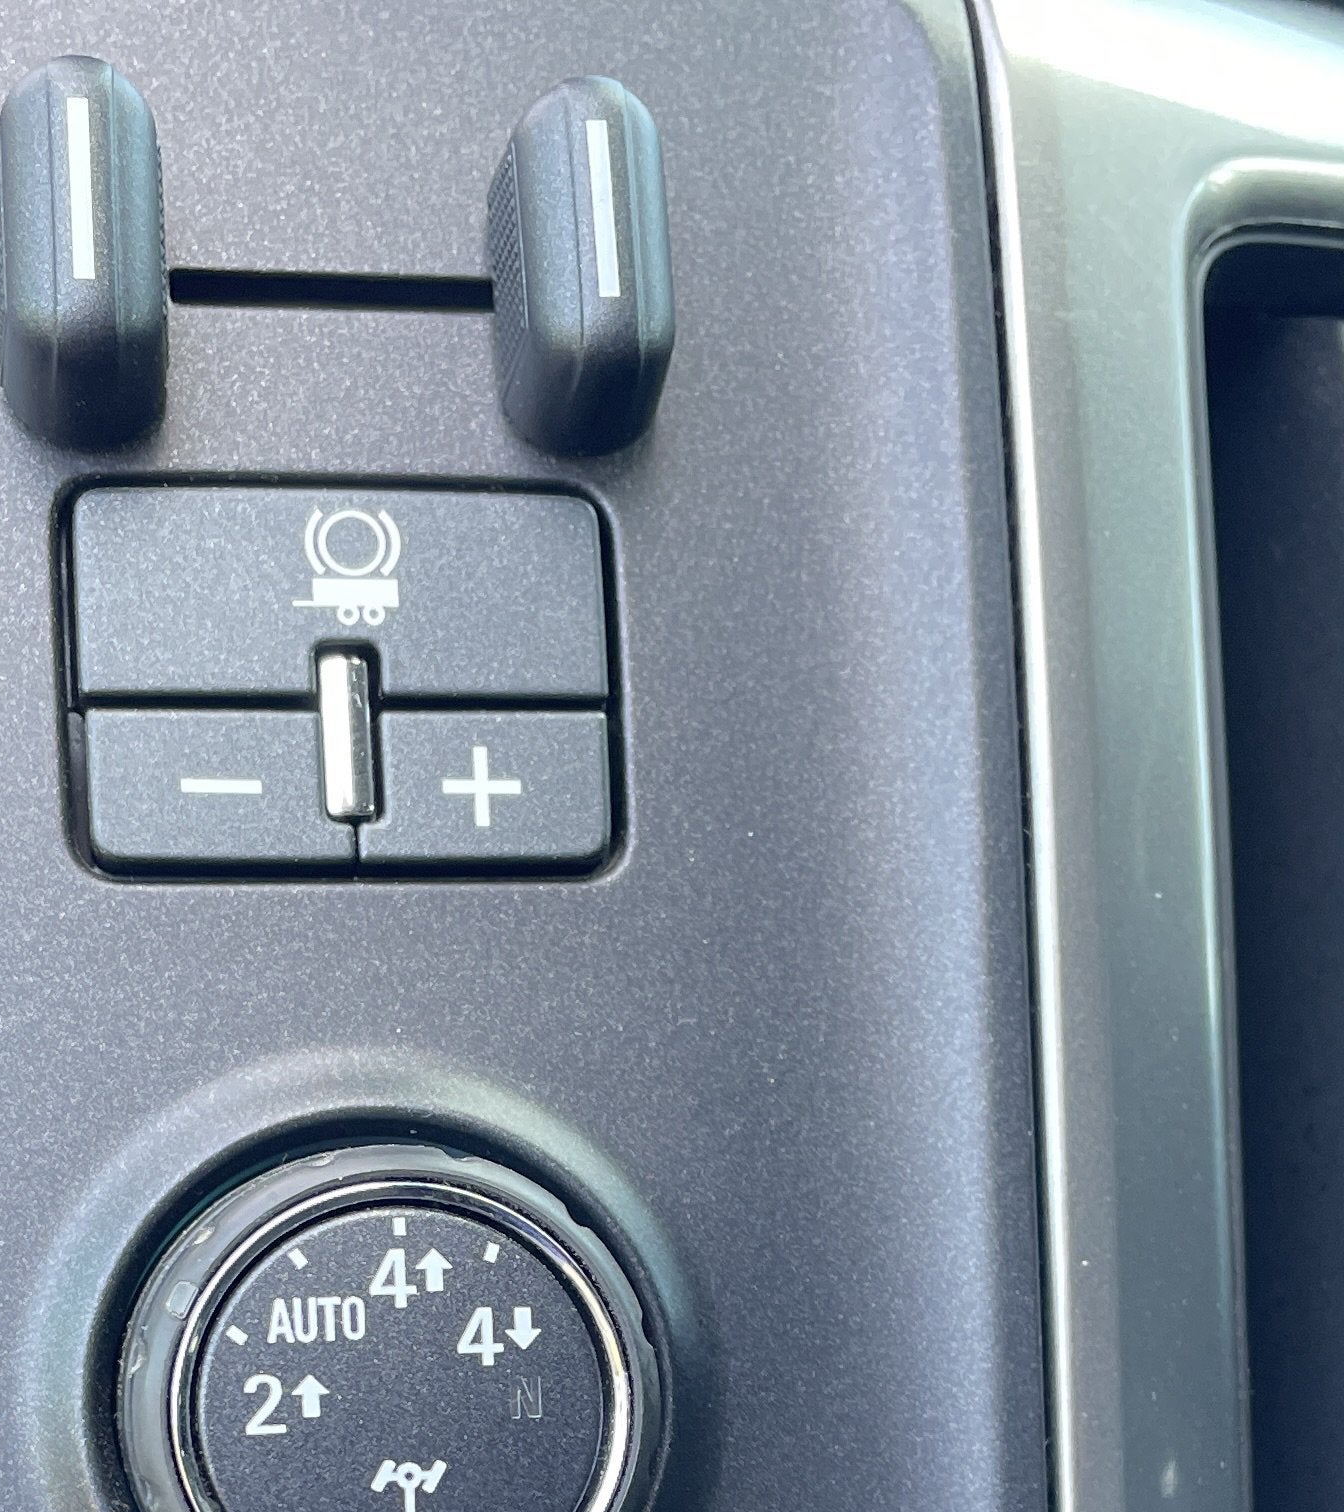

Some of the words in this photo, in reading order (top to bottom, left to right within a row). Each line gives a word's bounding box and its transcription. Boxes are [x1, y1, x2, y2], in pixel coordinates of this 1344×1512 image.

[369, 1248, 417, 1309] 4
[266, 1296, 367, 1345] AUTO
[457, 1306, 504, 1366] 4
[243, 1374, 287, 1436] 2
[511, 1375, 543, 1420] N
